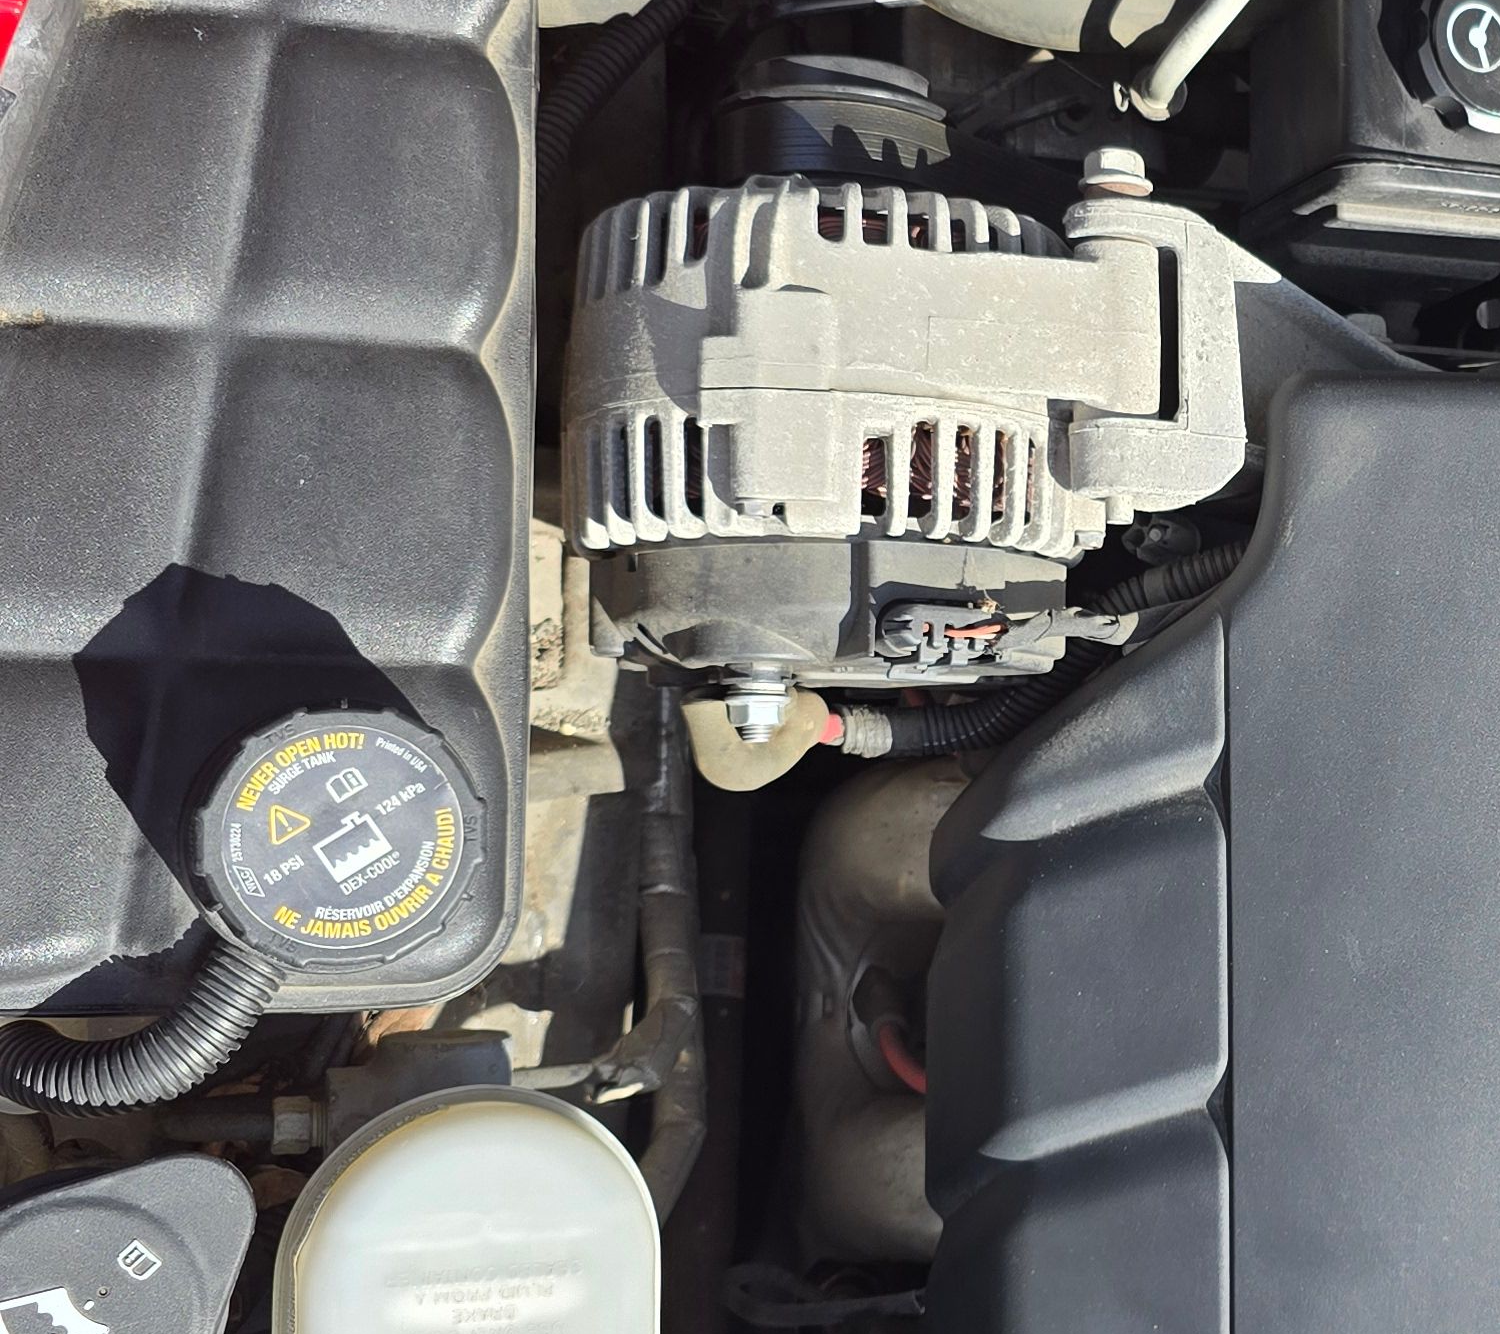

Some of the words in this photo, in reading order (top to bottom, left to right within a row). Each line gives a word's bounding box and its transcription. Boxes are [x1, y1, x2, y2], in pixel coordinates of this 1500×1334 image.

[236, 760, 279, 812] NEVER
[275, 736, 321, 766] OPEN
[323, 732, 366, 749] HOT!
[268, 761, 305, 795] SURGE
[304, 751, 336, 769] TANK
[375, 736, 405, 757] Printed
[410, 757, 428, 773] USA
[375, 794, 400, 816] 124
[400, 781, 426, 801] kPa
[264, 869, 281, 886] 18
[280, 855, 305, 876] PSI
[273, 906, 301, 929] NE
[300, 919, 372, 939] JAMAIS
[374, 884, 433, 930] OUVRIR
[431, 807, 455, 871] CHAUD!
[315, 901, 386, 921] RÉSERVOIR
[385, 841, 436, 908] D'EXPANSION
